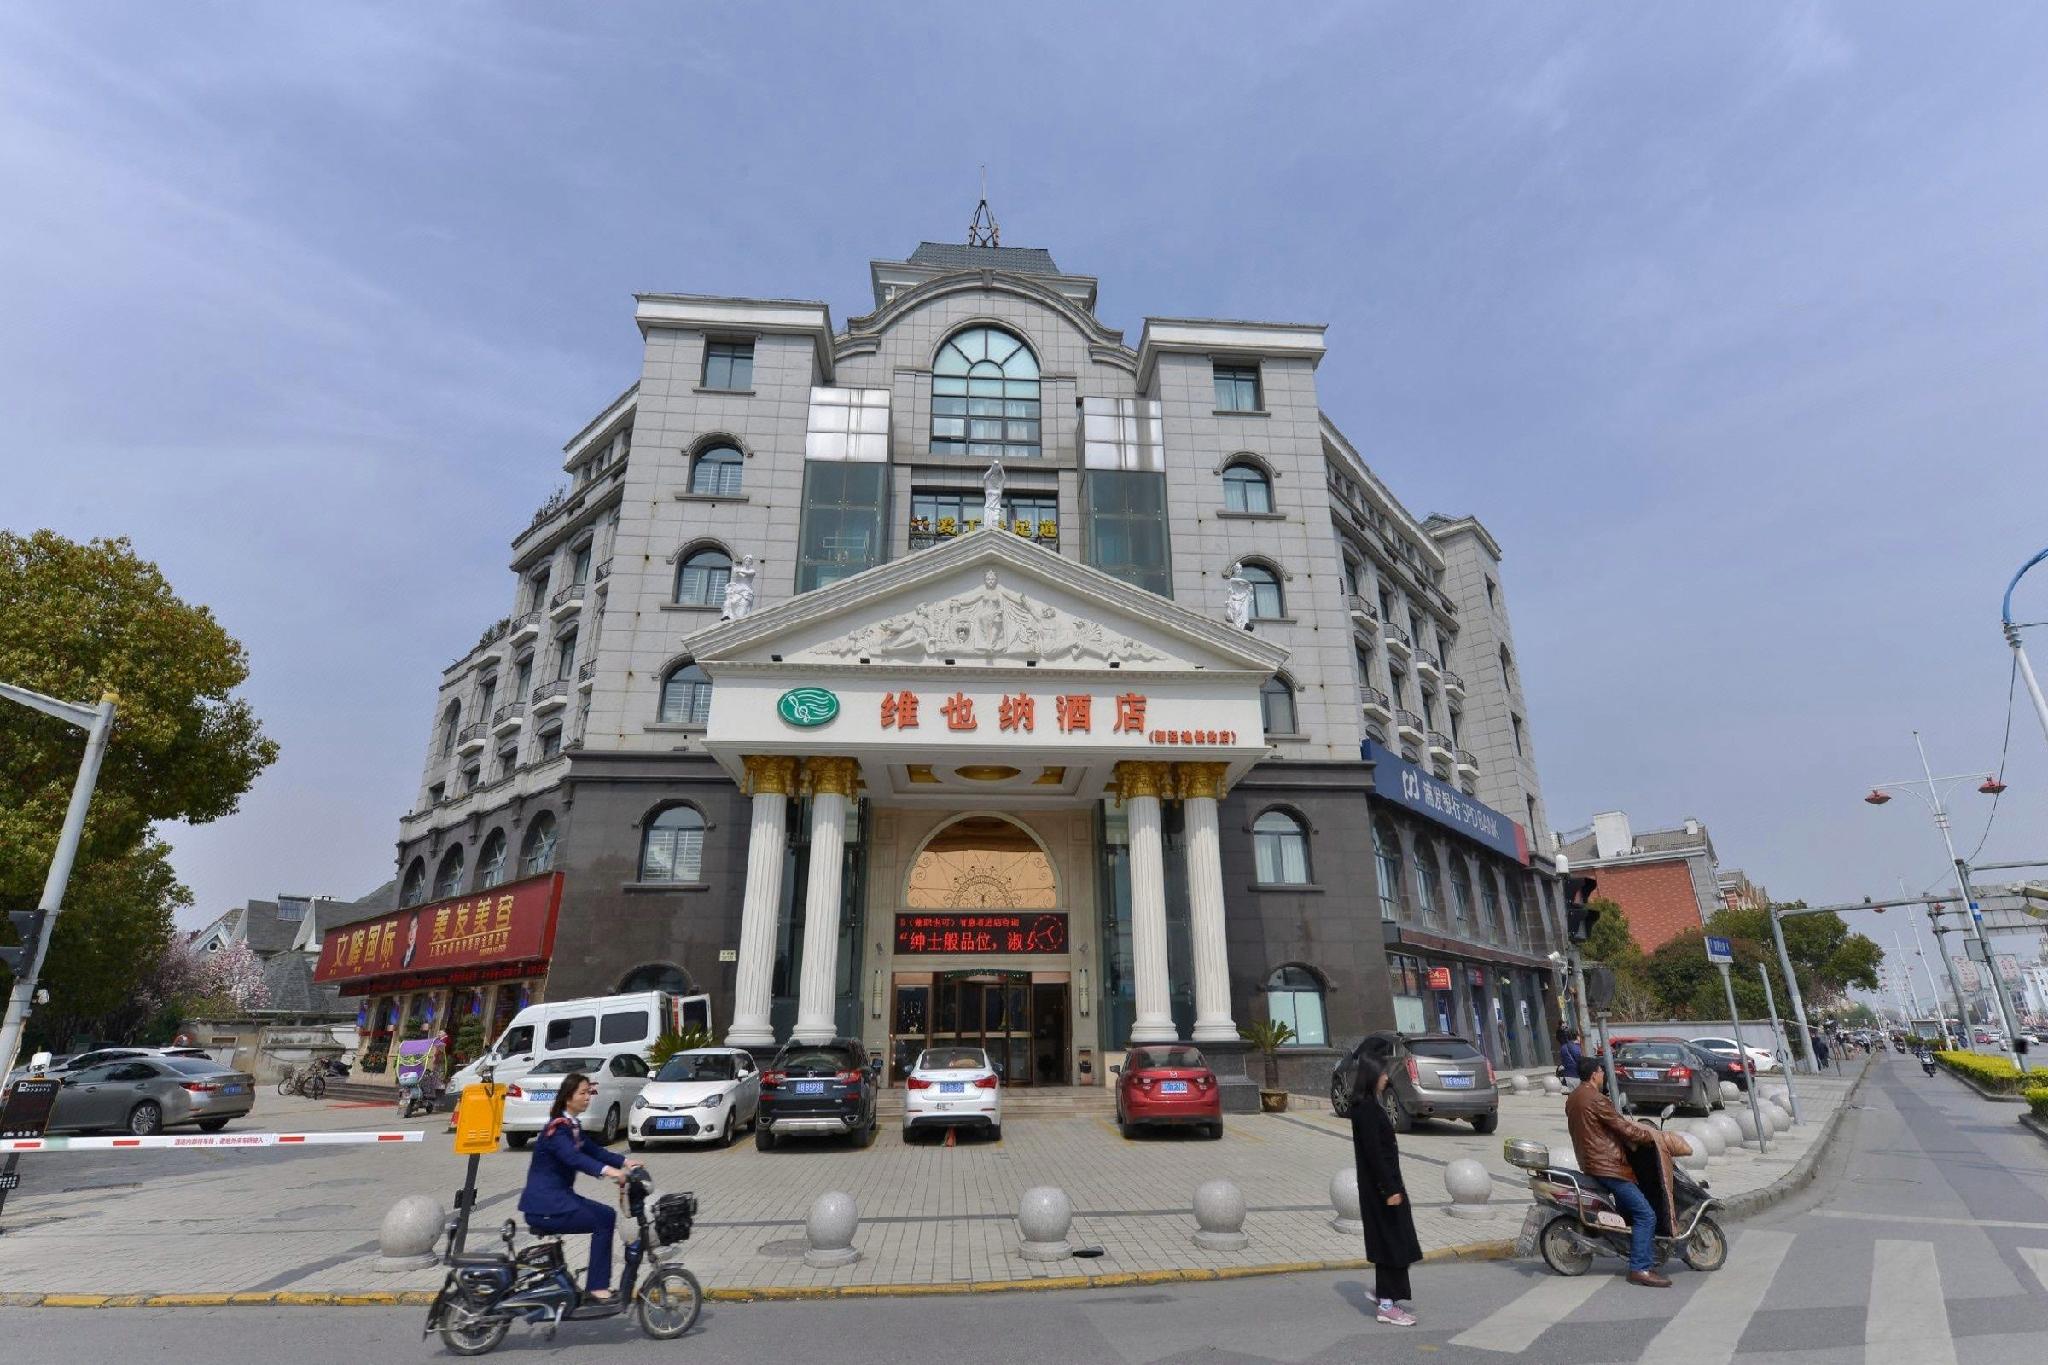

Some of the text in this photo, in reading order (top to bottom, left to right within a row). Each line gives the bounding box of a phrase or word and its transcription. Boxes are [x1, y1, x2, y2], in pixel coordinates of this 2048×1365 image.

[880, 691, 1147, 735] 维也纳酒店
[1422, 779, 1461, 821] 浦发银行
[432, 894, 514, 941] 美发美容
[335, 920, 399, 968] 文峰国际
